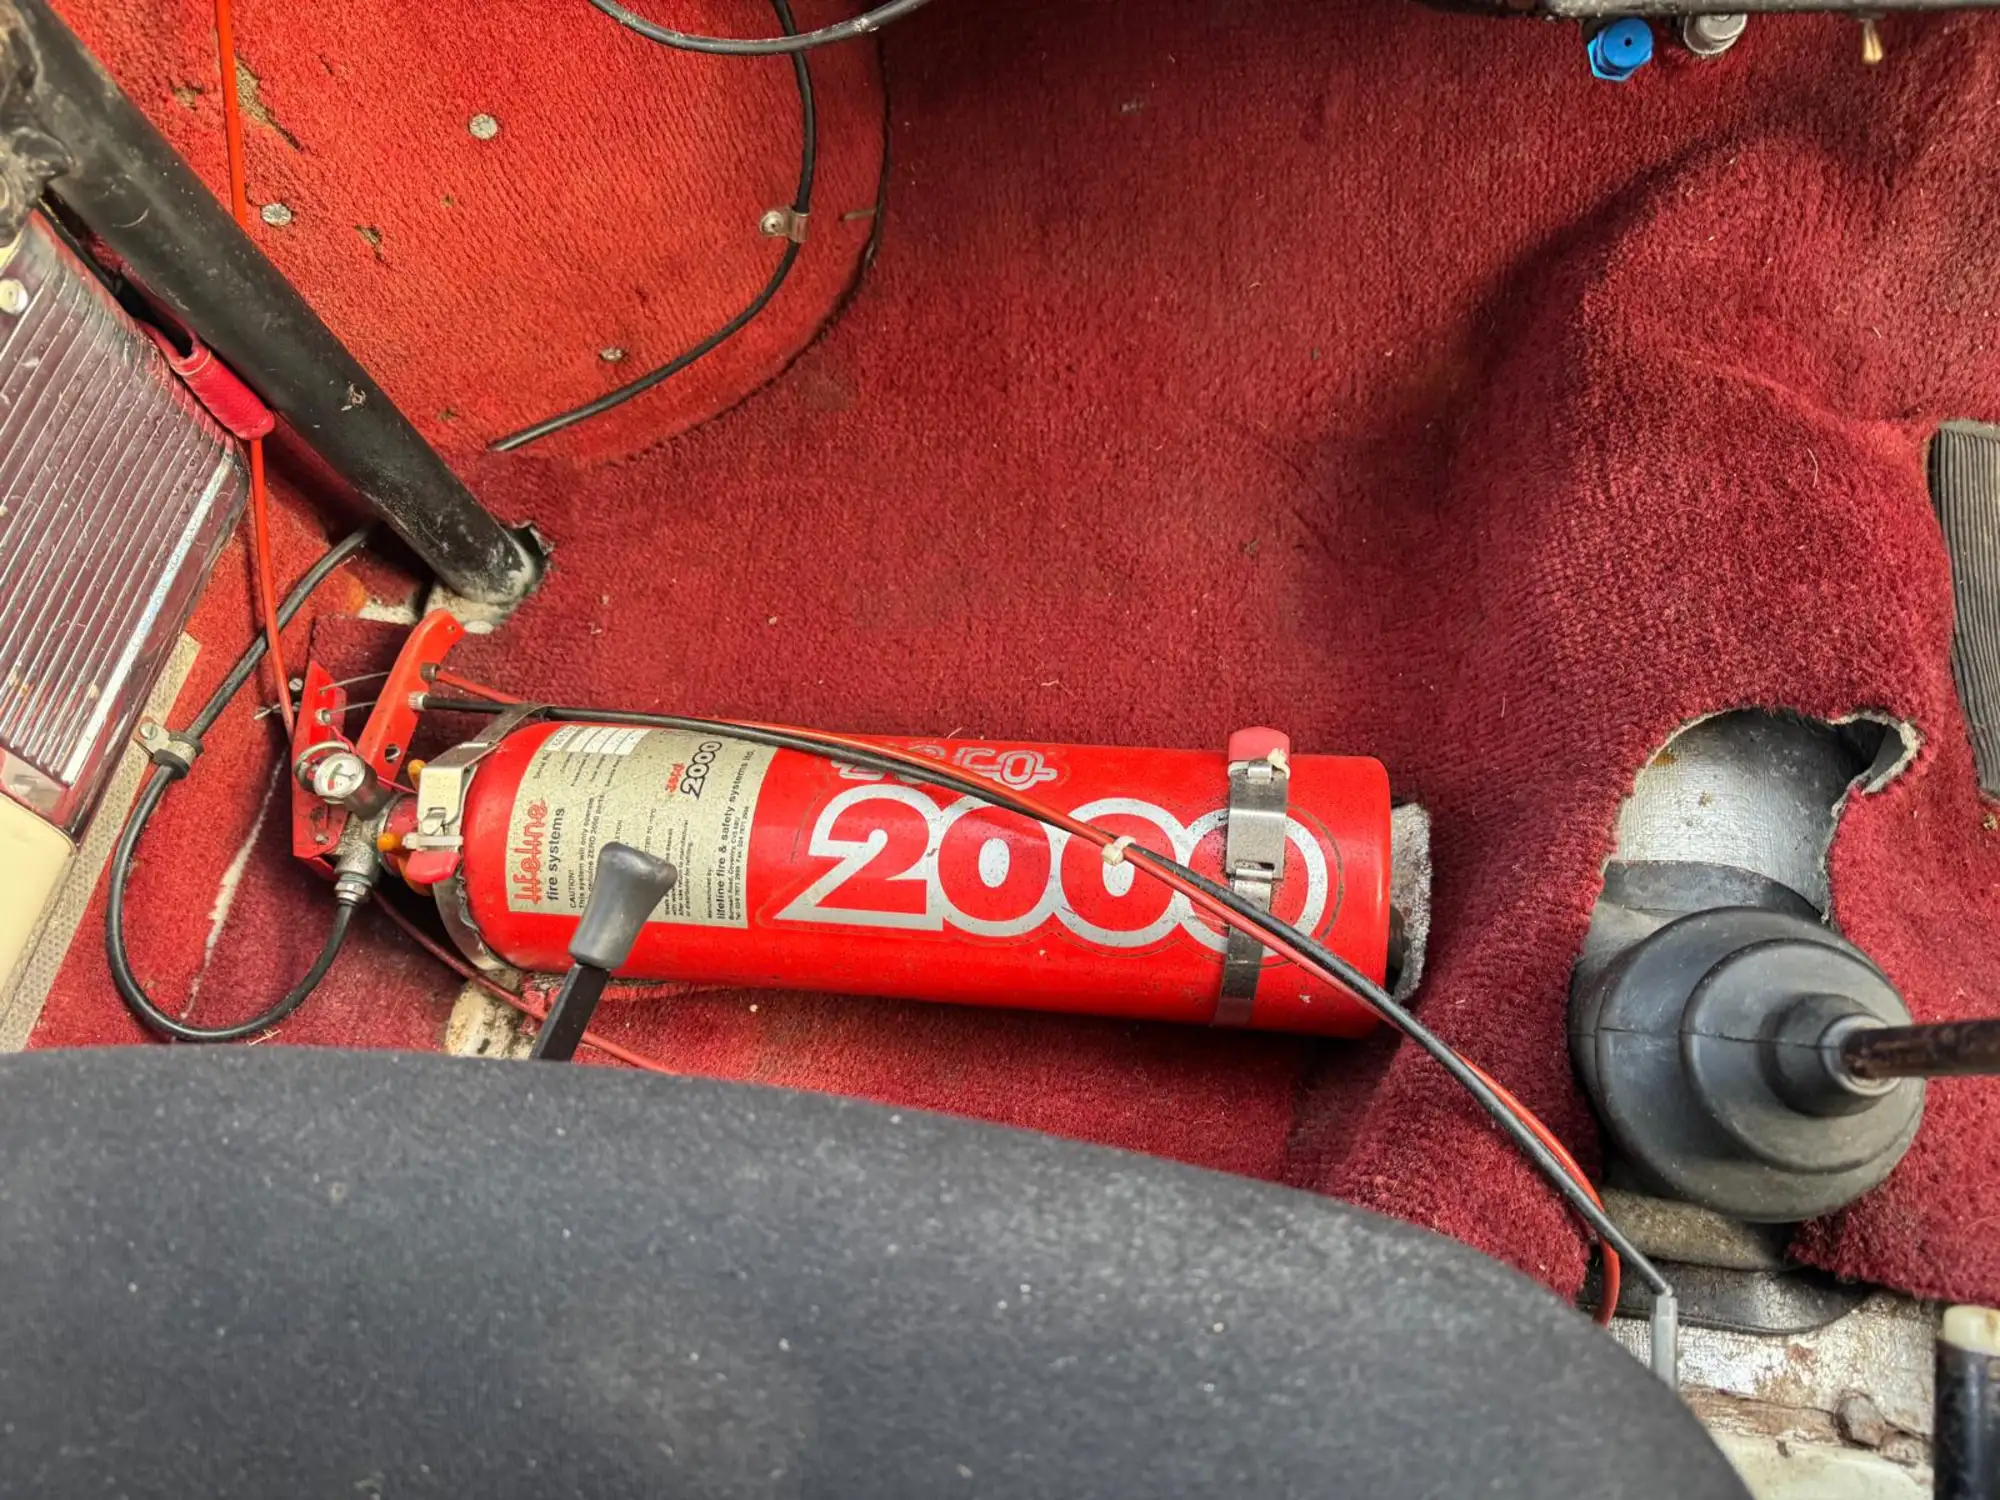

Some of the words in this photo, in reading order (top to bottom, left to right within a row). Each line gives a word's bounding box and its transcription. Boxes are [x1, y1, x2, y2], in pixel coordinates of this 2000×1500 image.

[680, 741, 722, 800] 2000
[728, 762, 748, 803] systems
[548, 808, 564, 872] systems
[719, 805, 735, 841] safety
[716, 857, 726, 877] fire
[718, 845, 726, 853] &
[546, 877, 559, 900] fire
[568, 870, 576, 908] CAUTION!
[774, 784, 1328, 957] 2000
[716, 880, 726, 919] lifeline
